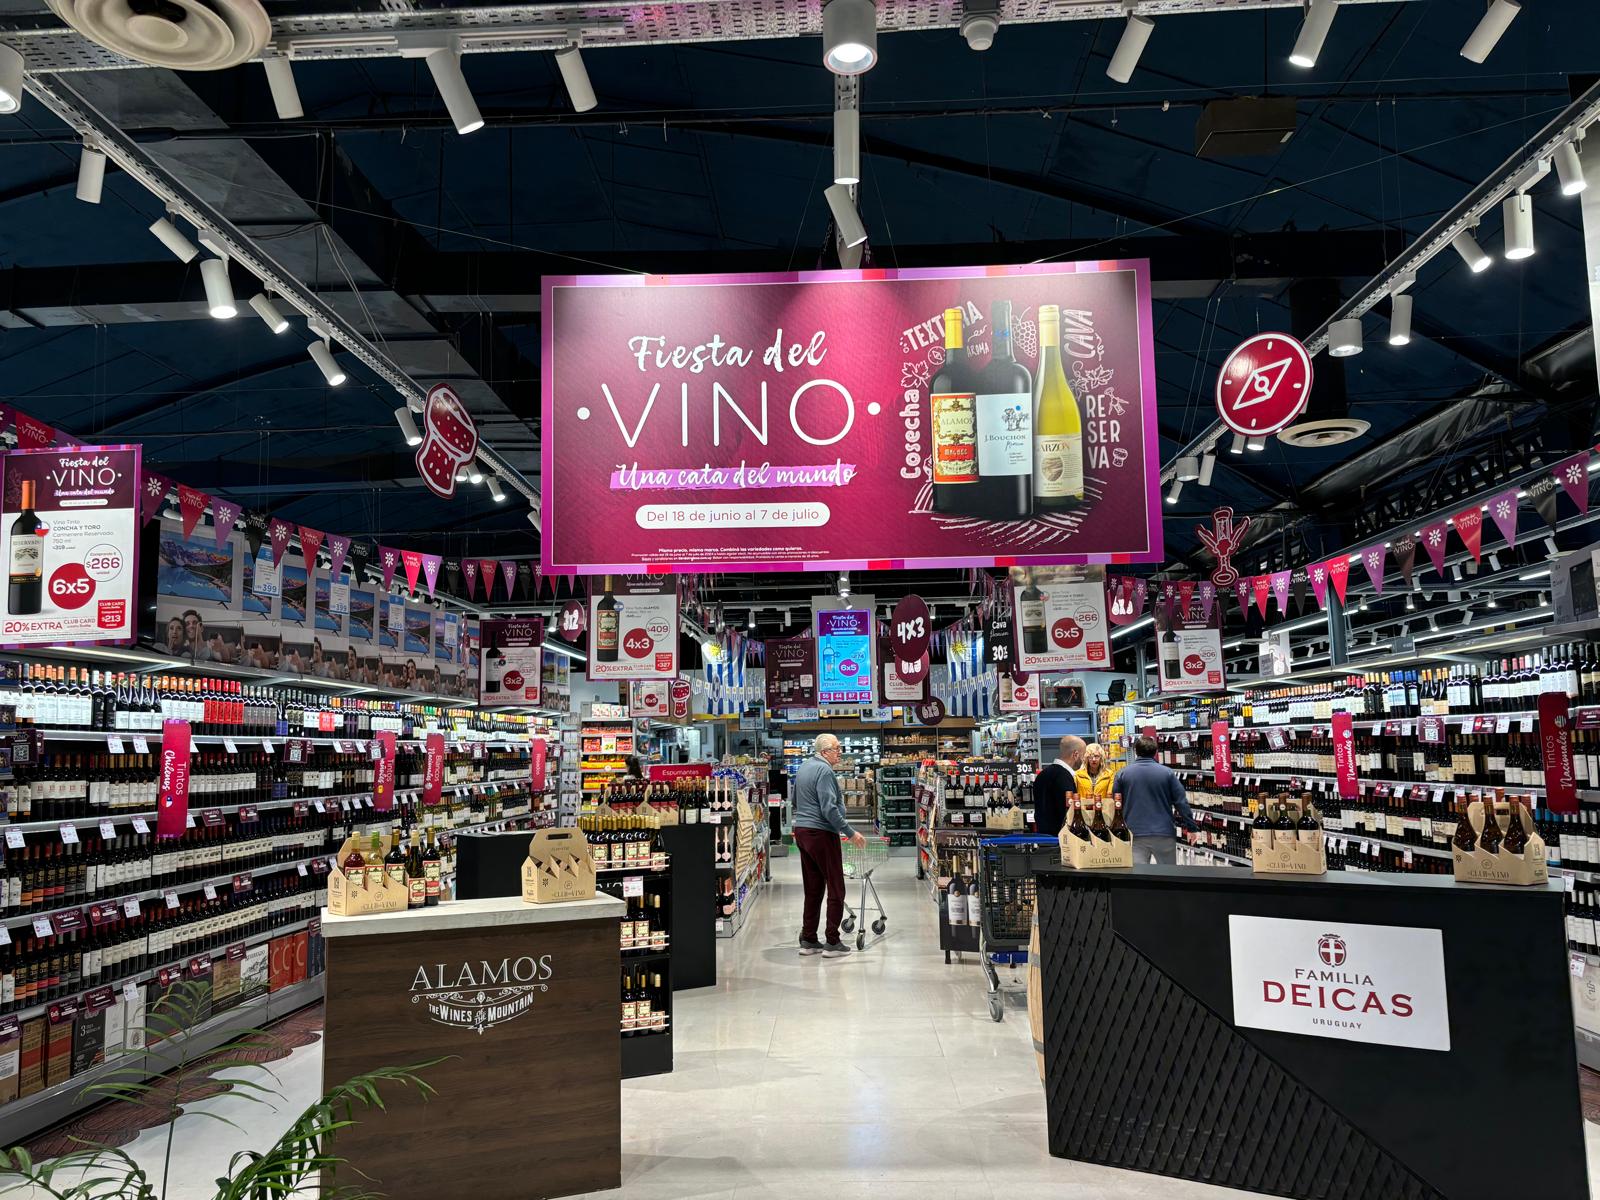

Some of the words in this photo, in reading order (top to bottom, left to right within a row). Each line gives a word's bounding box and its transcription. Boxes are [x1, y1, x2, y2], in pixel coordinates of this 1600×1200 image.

[903, 300, 984, 351] TEXTRA
[1063, 308, 1096, 359] CAVA
[628, 334, 752, 373] Fiesta
[763, 328, 827, 372] del
[966, 341, 990, 358] AROMA
[601, 378, 855, 448] VINO
[1086, 395, 1106, 418] RE
[22, 426, 46, 444] VINO
[899, 388, 921, 479] Cosecha
[1088, 420, 1121, 443] SER
[59, 458, 90, 468] Fiesta
[92, 456, 109, 467] del
[1088, 447, 1110, 469] VA
[52, 468, 115, 486] VINO
[616, 462, 673, 490] Una
[677, 463, 730, 485] cata
[733, 460, 770, 487] del
[776, 458, 857, 486] mundo
[1528, 482, 1554, 498] VINO
[182, 496, 204, 508] VINO
[647, 511, 668, 522] Del
[672, 511, 685, 521] 18
[690, 511, 706, 521] de
[710, 510, 742, 523] junio
[746, 510, 756, 521] al
[760, 510, 768, 520] 7
[772, 510, 788, 520] de
[792, 508, 819, 521] julio
[1458, 517, 1480, 530] VINO
[86, 557, 120, 570] $266
[52, 578, 90, 595] 6x5
[262, 584, 277, 593] 399
[992, 620, 1007, 629] Cava
[1075, 614, 1098, 622] $266
[4, 622, 30, 633] 20%
[31, 622, 63, 631] EXTRA
[504, 628, 532, 637] VINO
[1054, 628, 1080, 638] 6x5
[626, 638, 650, 649] 4x3
[775, 649, 805, 658] VINO
[1025, 656, 1042, 664] 20%
[1186, 661, 1203, 669] 3x2
[505, 677, 522, 685] 3x2
[1344, 740, 1356, 782] Nacionales
[1546, 735, 1556, 770] Tintos
[1560, 730, 1570, 790] Nacionales
[162, 750, 175, 791] Chilenos
[386, 759, 394, 782] Tintos
[426, 748, 435, 783] Nacionales
[176, 762, 186, 795] Tintos
[408, 954, 553, 992] ALAMOS
[1295, 968, 1374, 986] FAMILIA
[429, 1003, 439, 1016] THE
[439, 1004, 472, 1023] WINES
[488, 992, 534, 1022] MOUNTAIN
[1263, 980, 1413, 1018] DEICAS
[1312, 1018, 1362, 1030] URUGUAY
